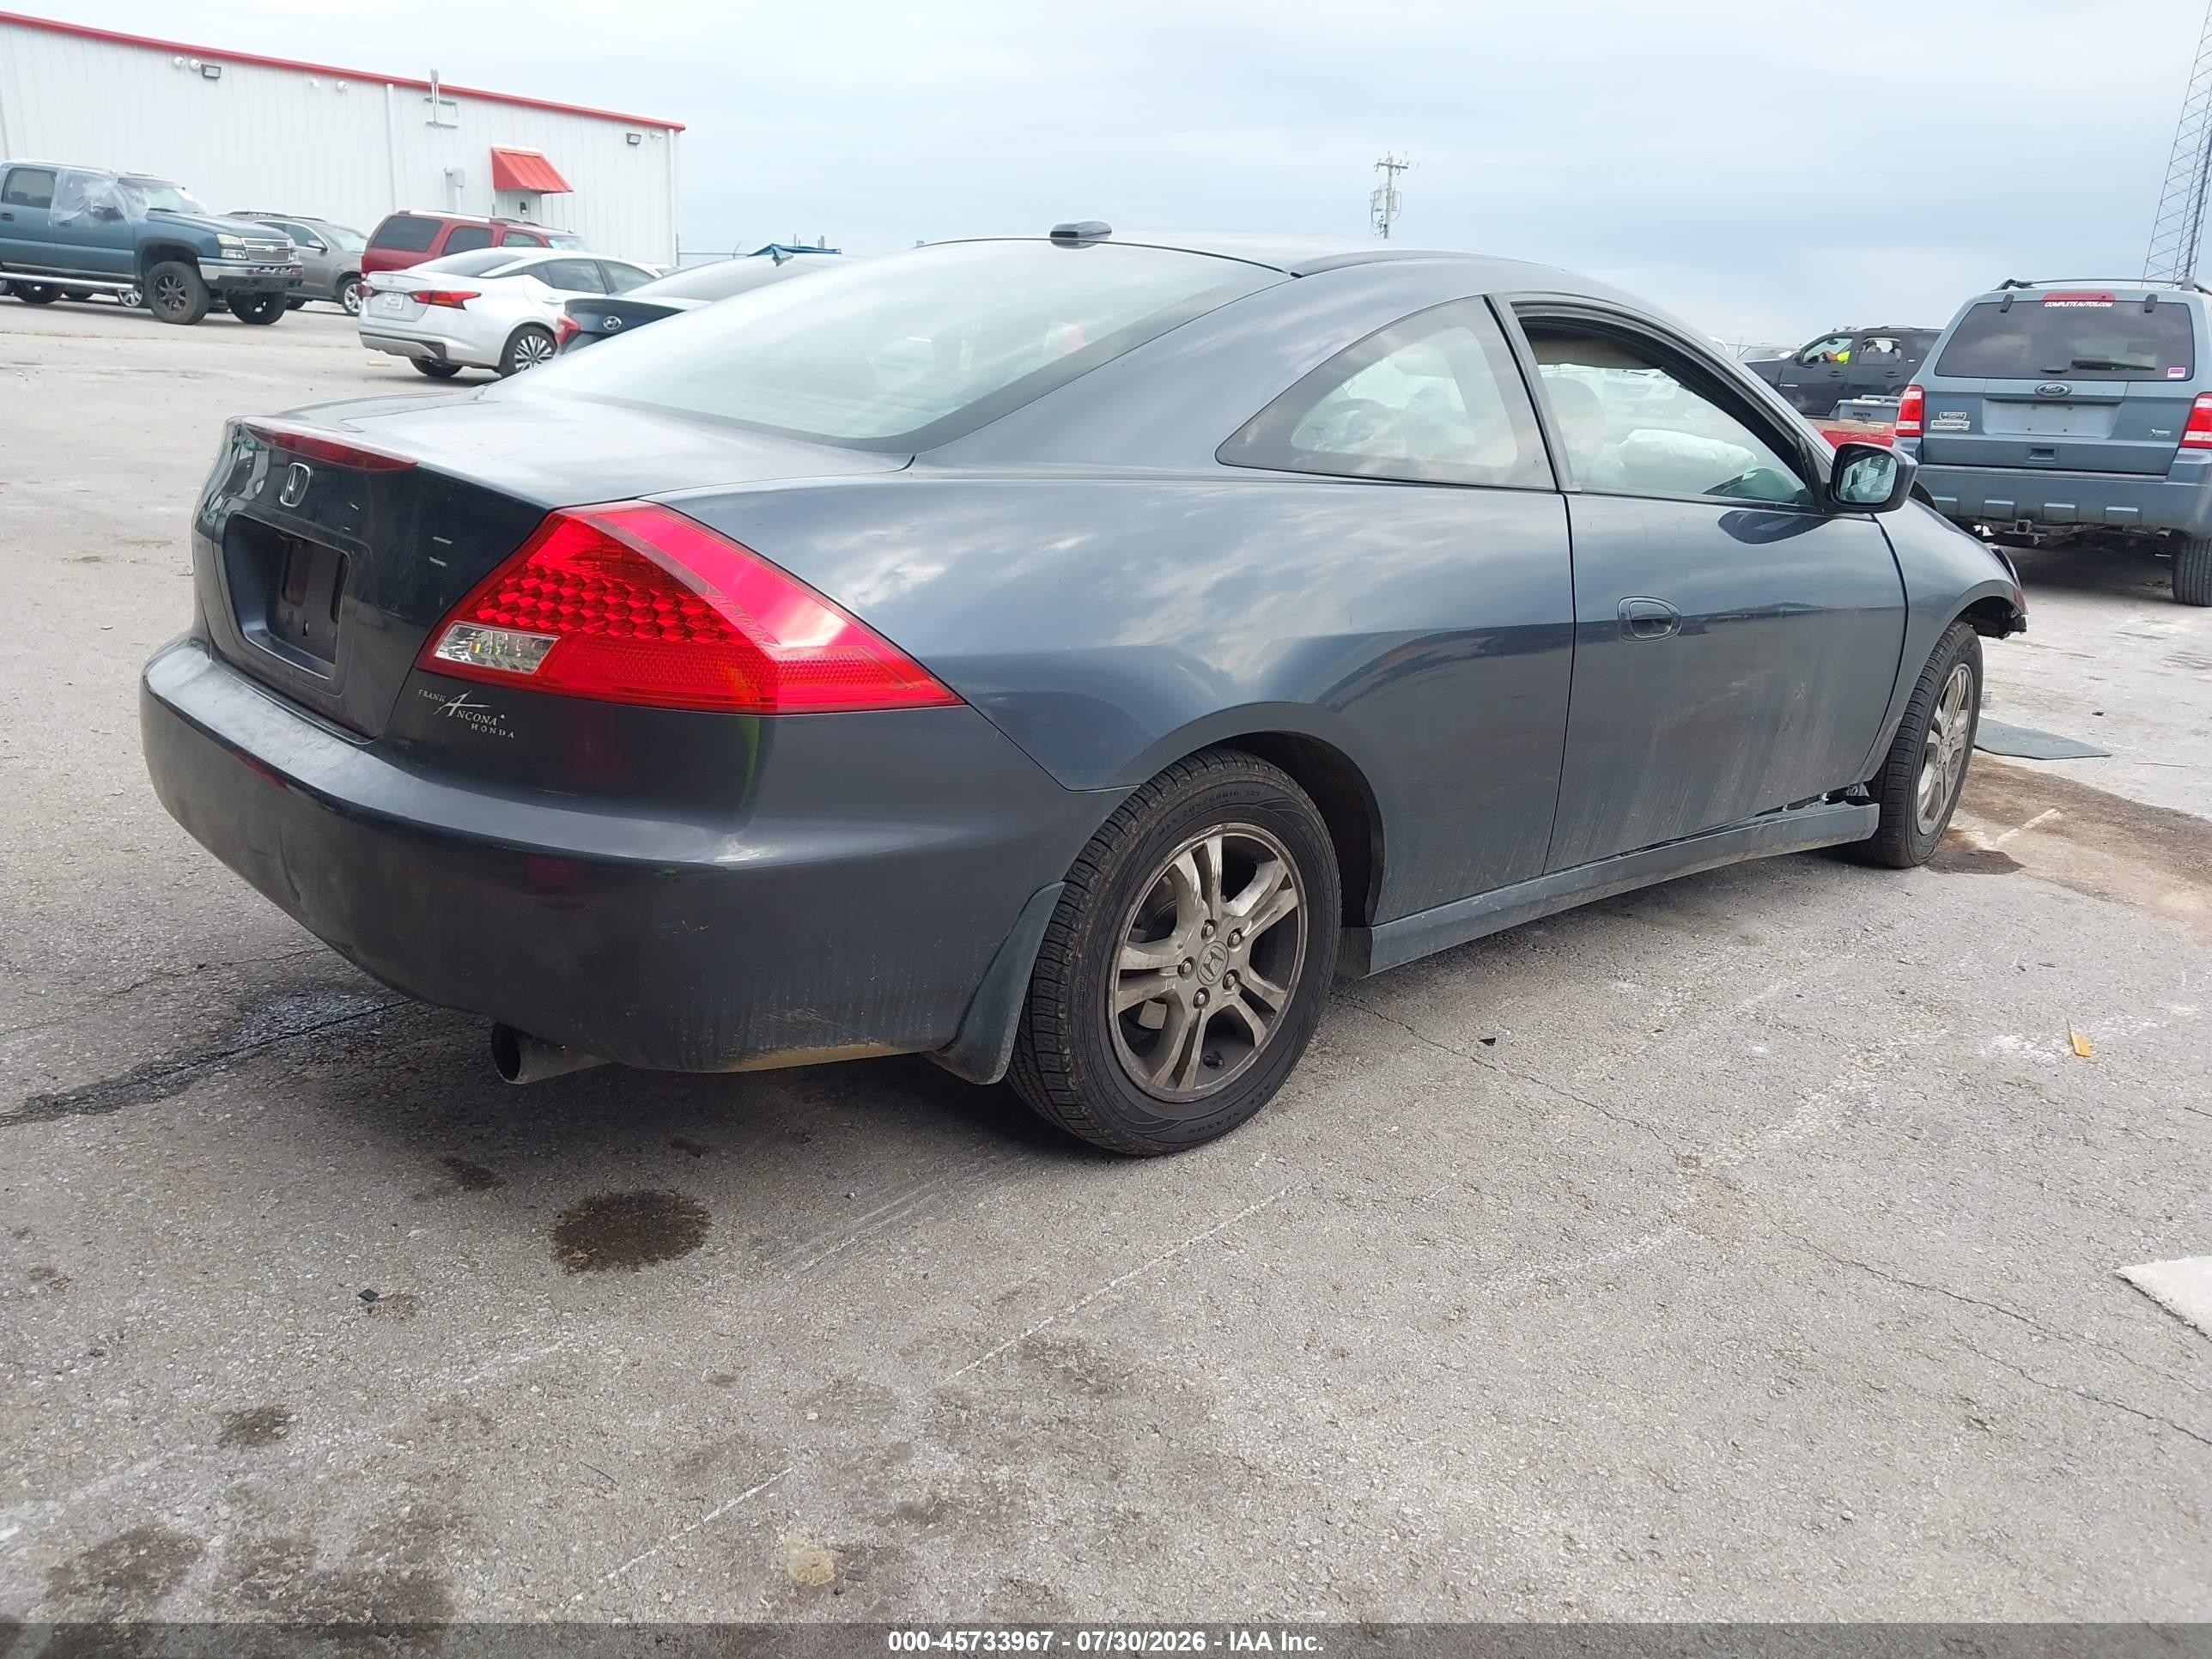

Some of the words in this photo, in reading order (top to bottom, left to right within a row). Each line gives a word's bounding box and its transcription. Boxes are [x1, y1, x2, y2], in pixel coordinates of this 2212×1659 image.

[418, 689, 447, 702] FRANK
[433, 690, 498, 726] ANCONA
[471, 722, 515, 738] HONDA
